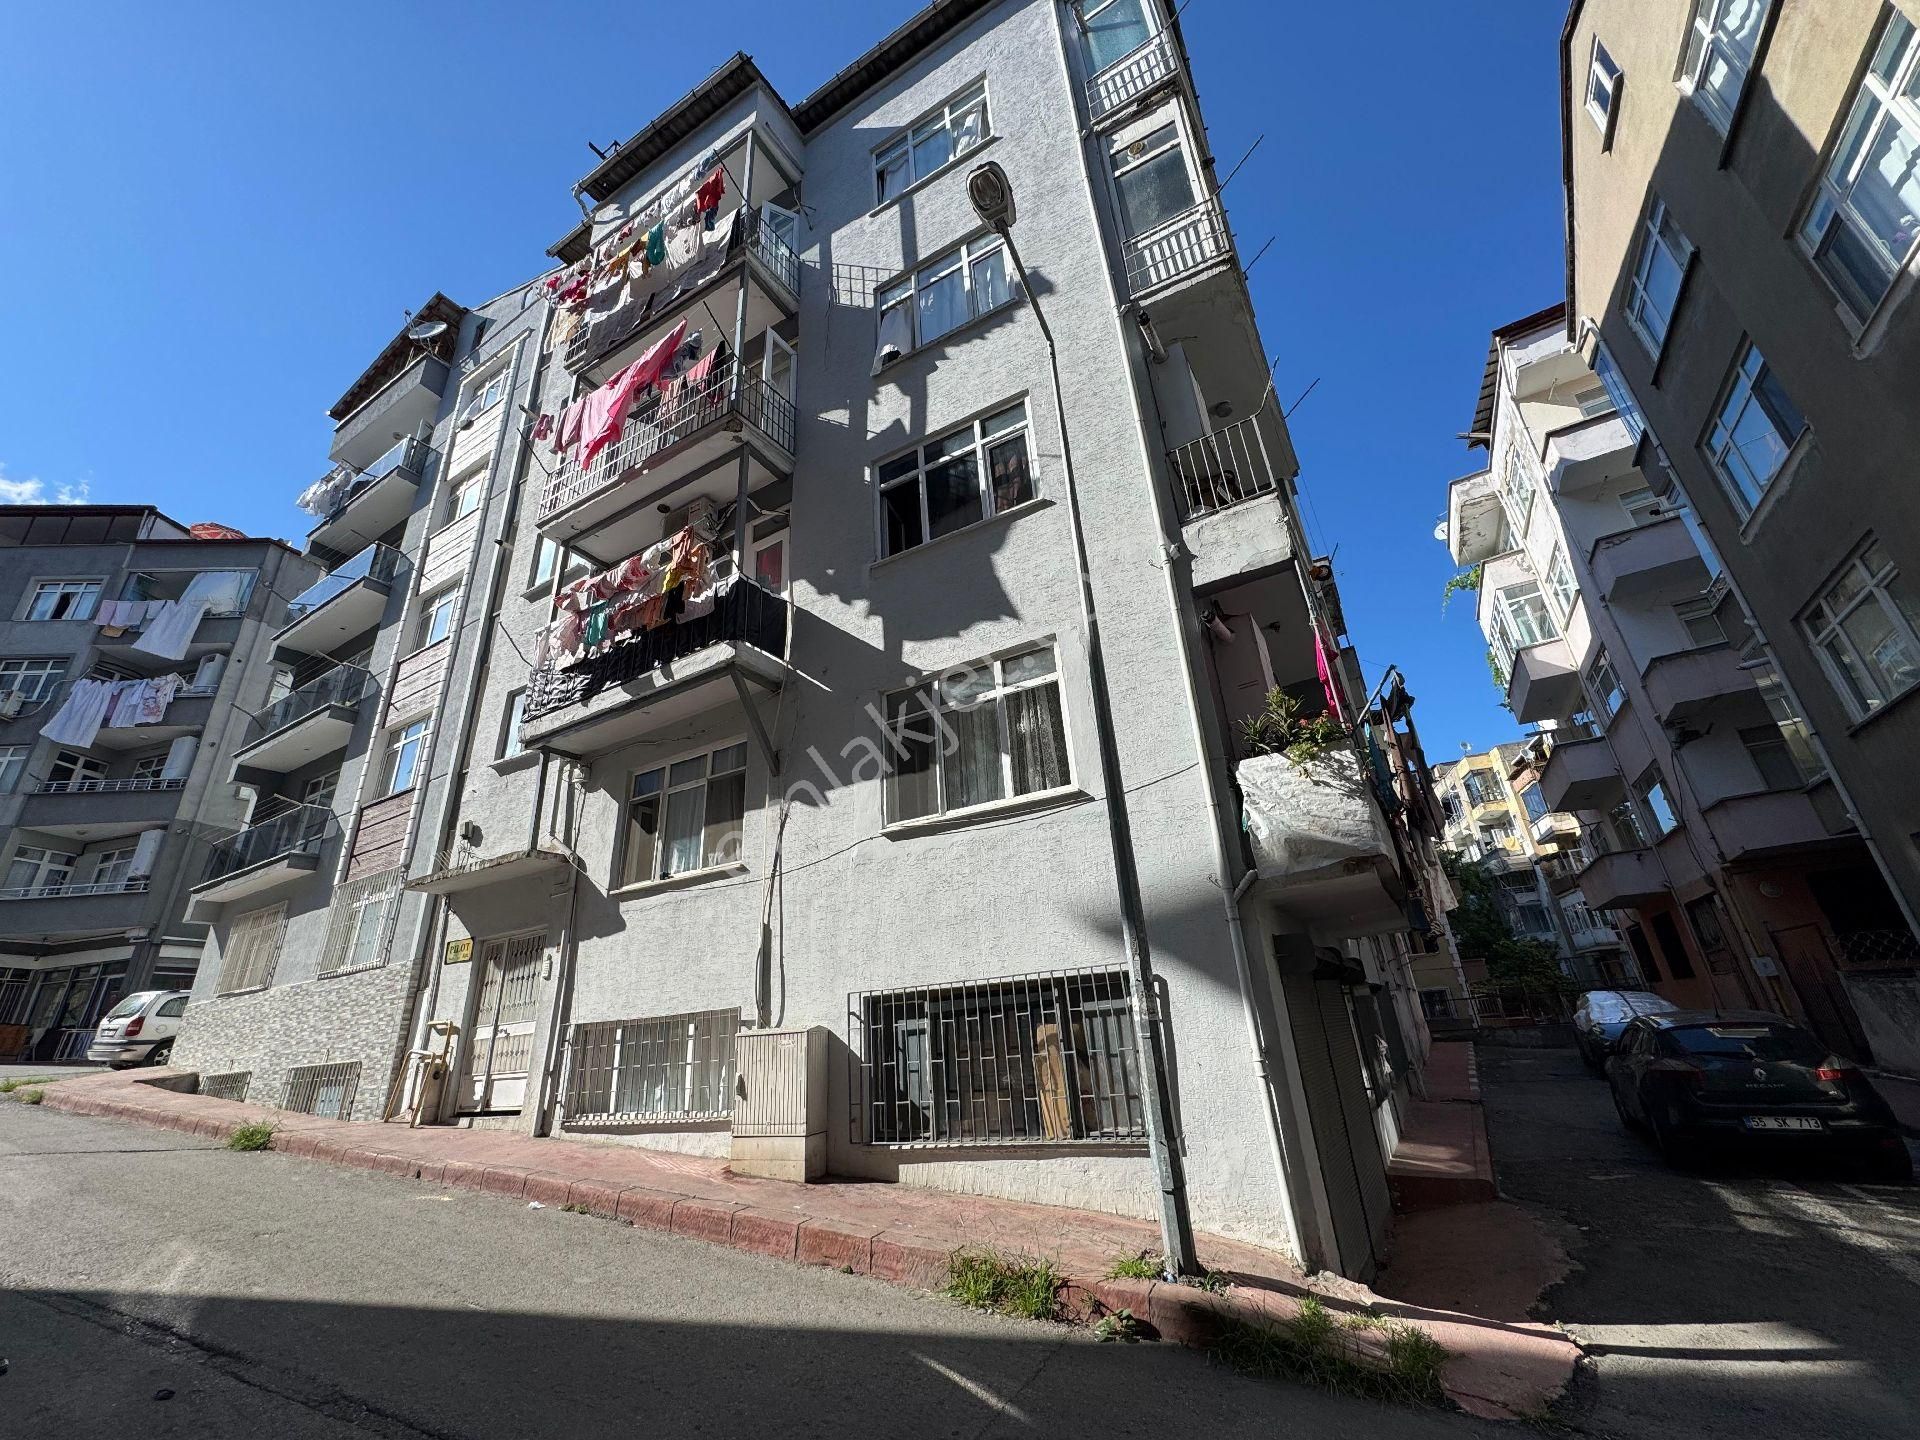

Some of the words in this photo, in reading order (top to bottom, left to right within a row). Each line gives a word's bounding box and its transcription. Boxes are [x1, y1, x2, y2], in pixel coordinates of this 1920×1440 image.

[450, 943, 471, 954] PILOT
[1751, 1117, 1766, 1127] 55
[1774, 1117, 1790, 1128] SK
[1796, 1117, 1820, 1129] 713
